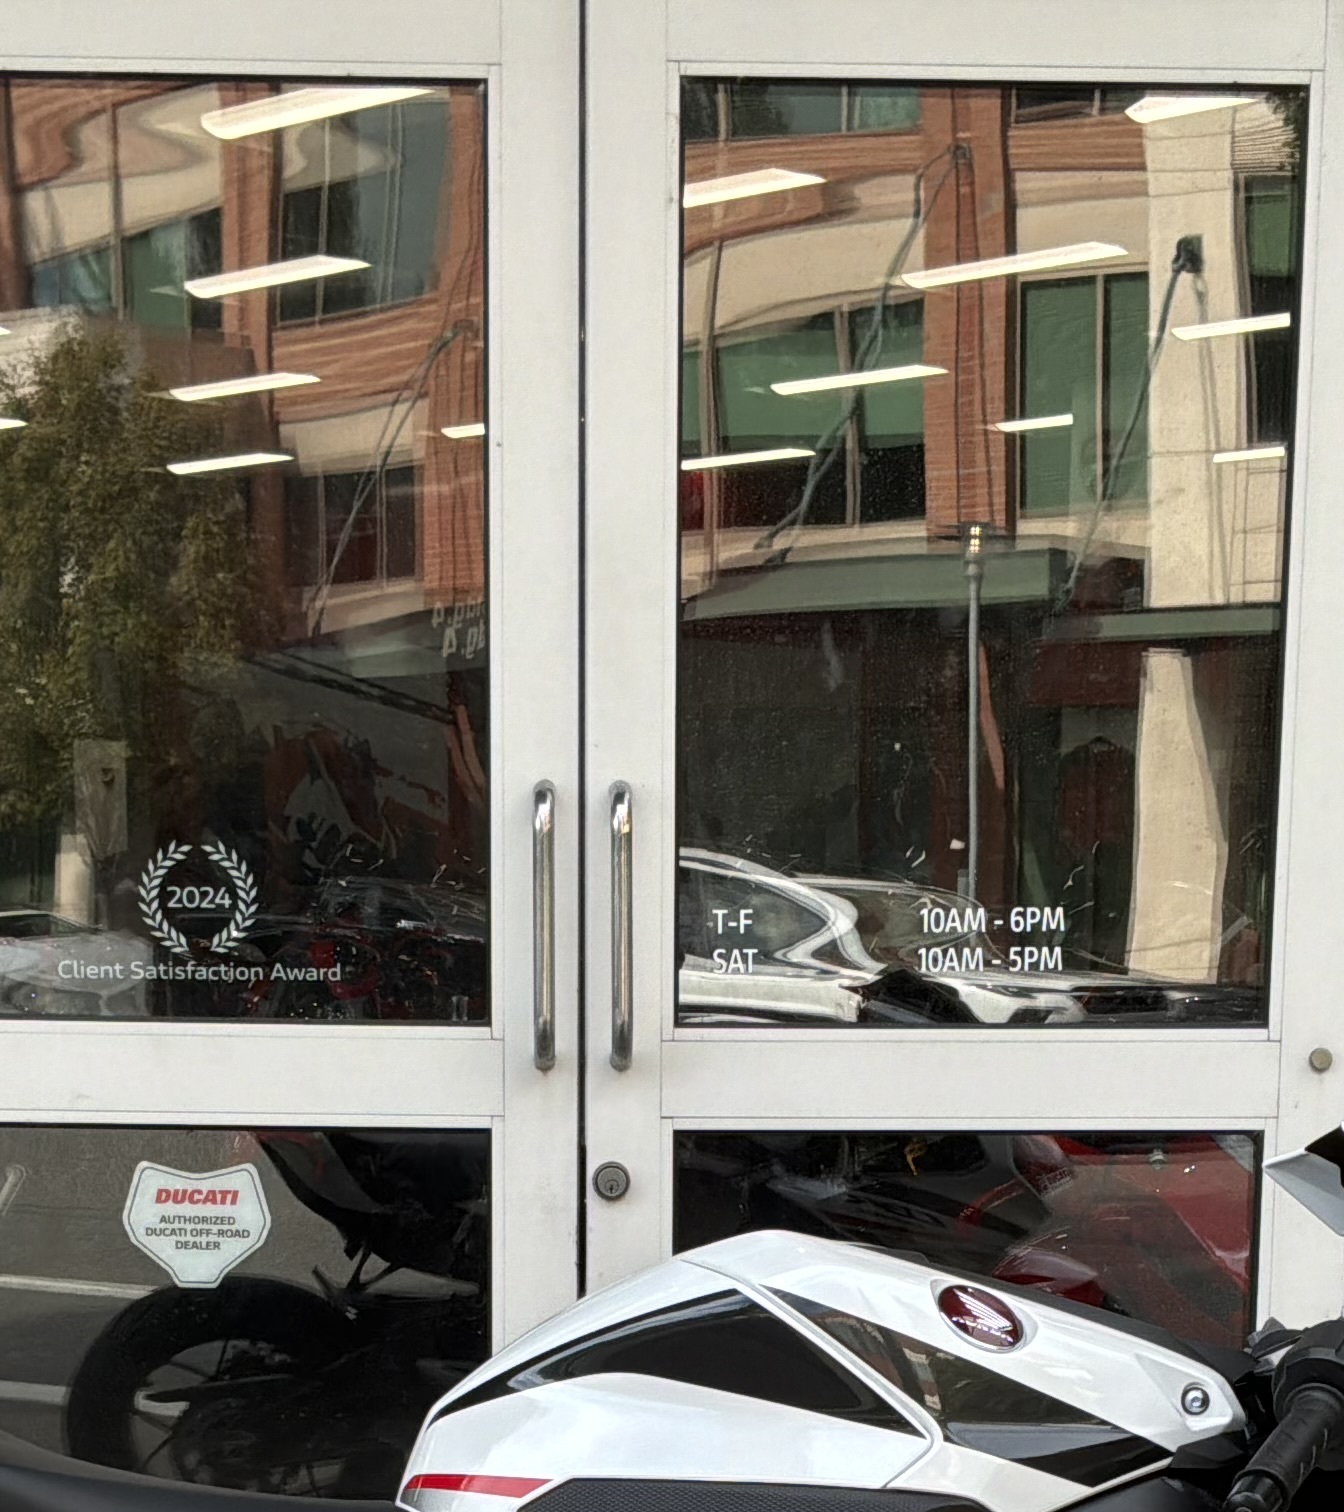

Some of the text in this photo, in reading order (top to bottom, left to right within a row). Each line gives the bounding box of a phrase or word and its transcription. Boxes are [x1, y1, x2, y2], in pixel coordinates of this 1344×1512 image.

[167, 886, 233, 909] 2024
[711, 909, 754, 934] T-F
[919, 908, 986, 932] 10AM
[1010, 907, 1066, 932] 6PM
[711, 948, 758, 974] SAT
[918, 948, 984, 972] 10AM
[1008, 947, 1063, 972] 5PM
[58, 960, 342, 983] Client Satisfaction Award
[154, 1188, 240, 1206] DUCATI
[159, 1215, 236, 1226] AUTHORIZED
[145, 1227, 251, 1239] DUCATI OFF-ROAD
[175, 1240, 222, 1251] DEALER
